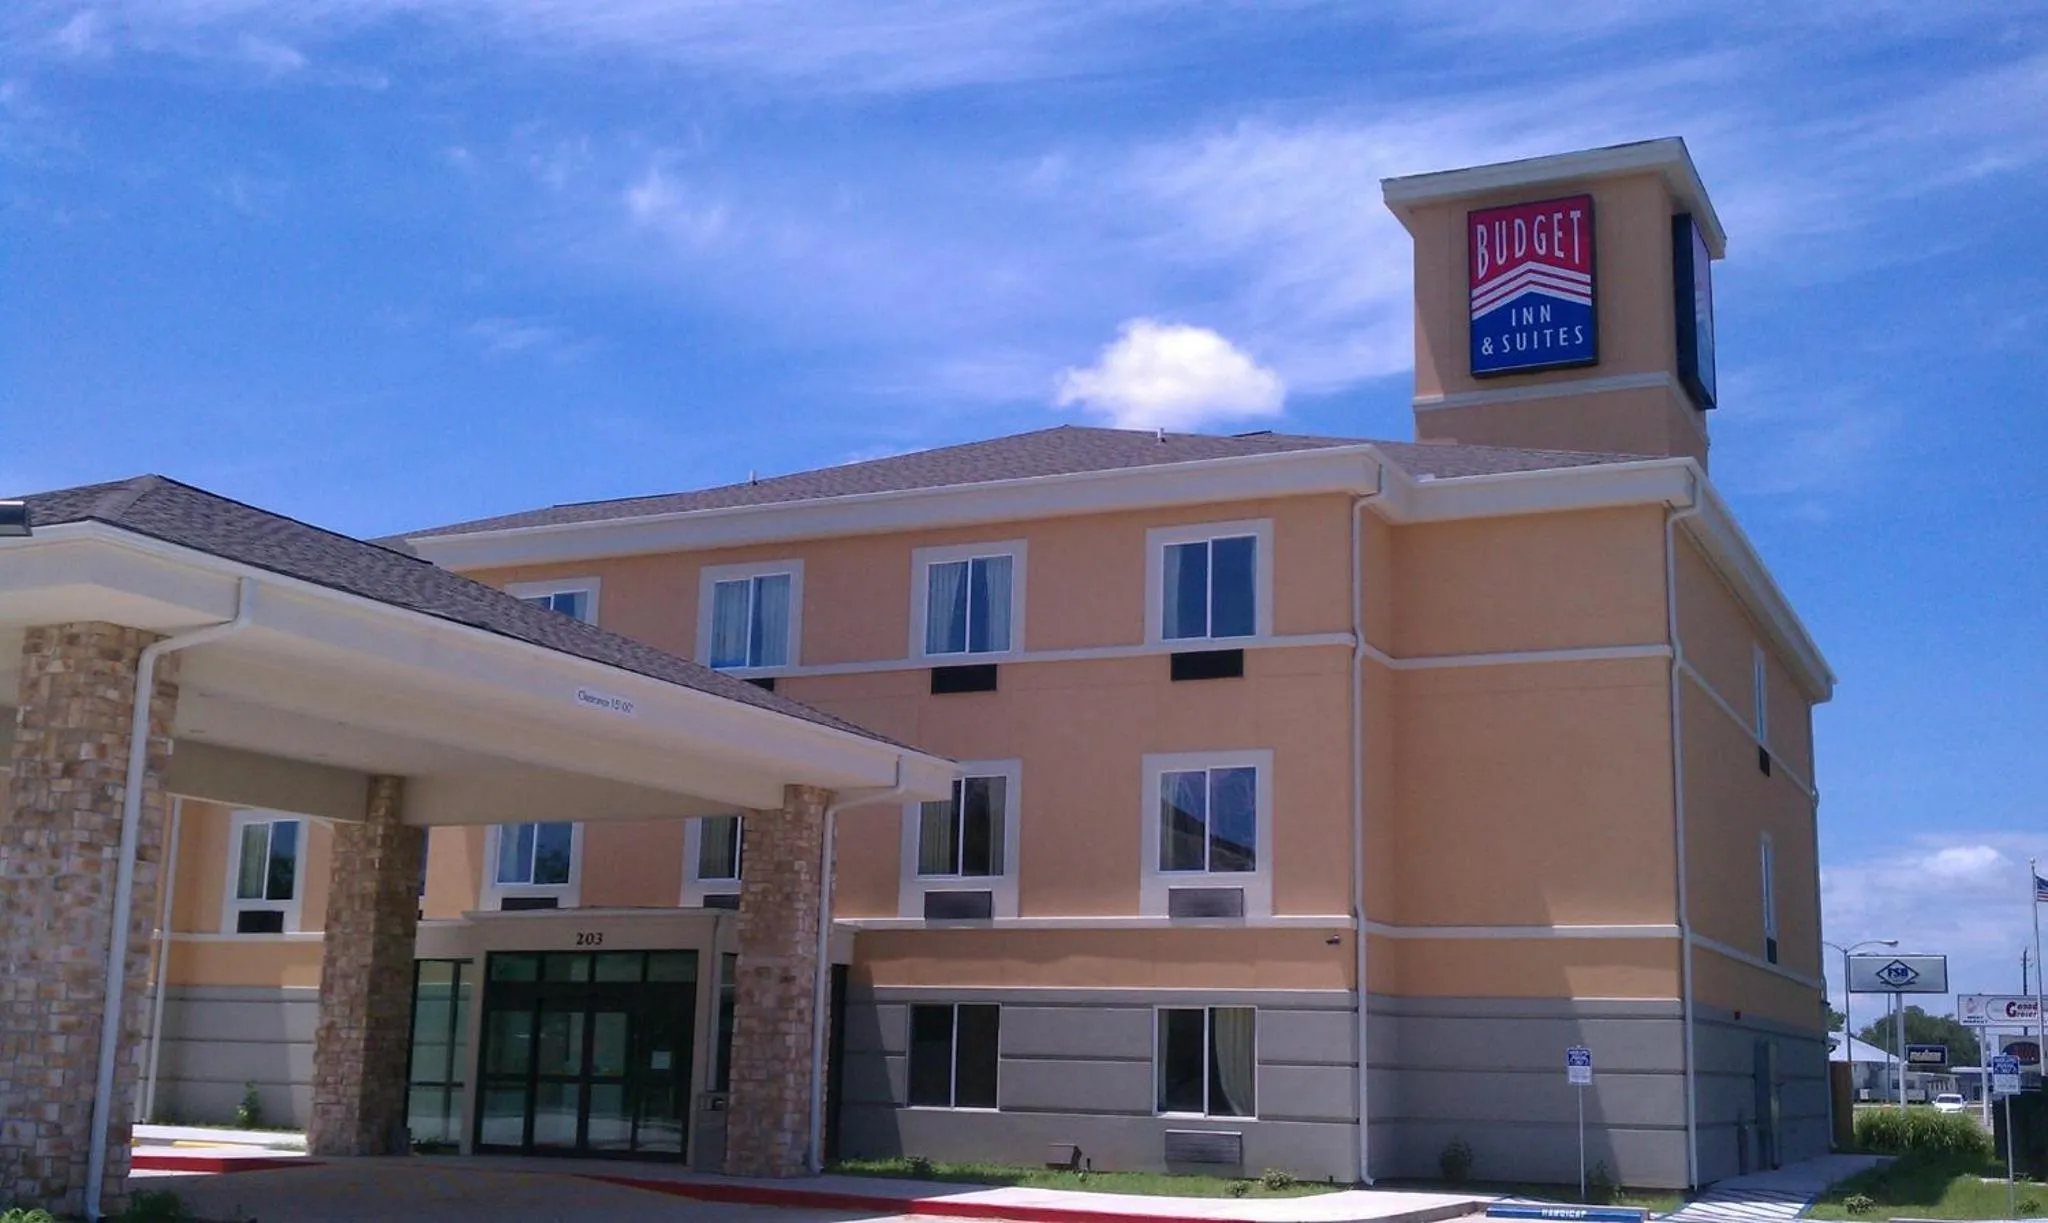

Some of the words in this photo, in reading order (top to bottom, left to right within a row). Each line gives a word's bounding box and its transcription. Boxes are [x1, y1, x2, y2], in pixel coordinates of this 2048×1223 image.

[1476, 210, 1581, 280] BUDGET
[1511, 304, 1551, 327] INN
[1481, 336, 1494, 355] &
[1502, 325, 1584, 353] SUITES
[576, 932, 604, 946] 203
[1887, 967, 1909, 978] FSB
